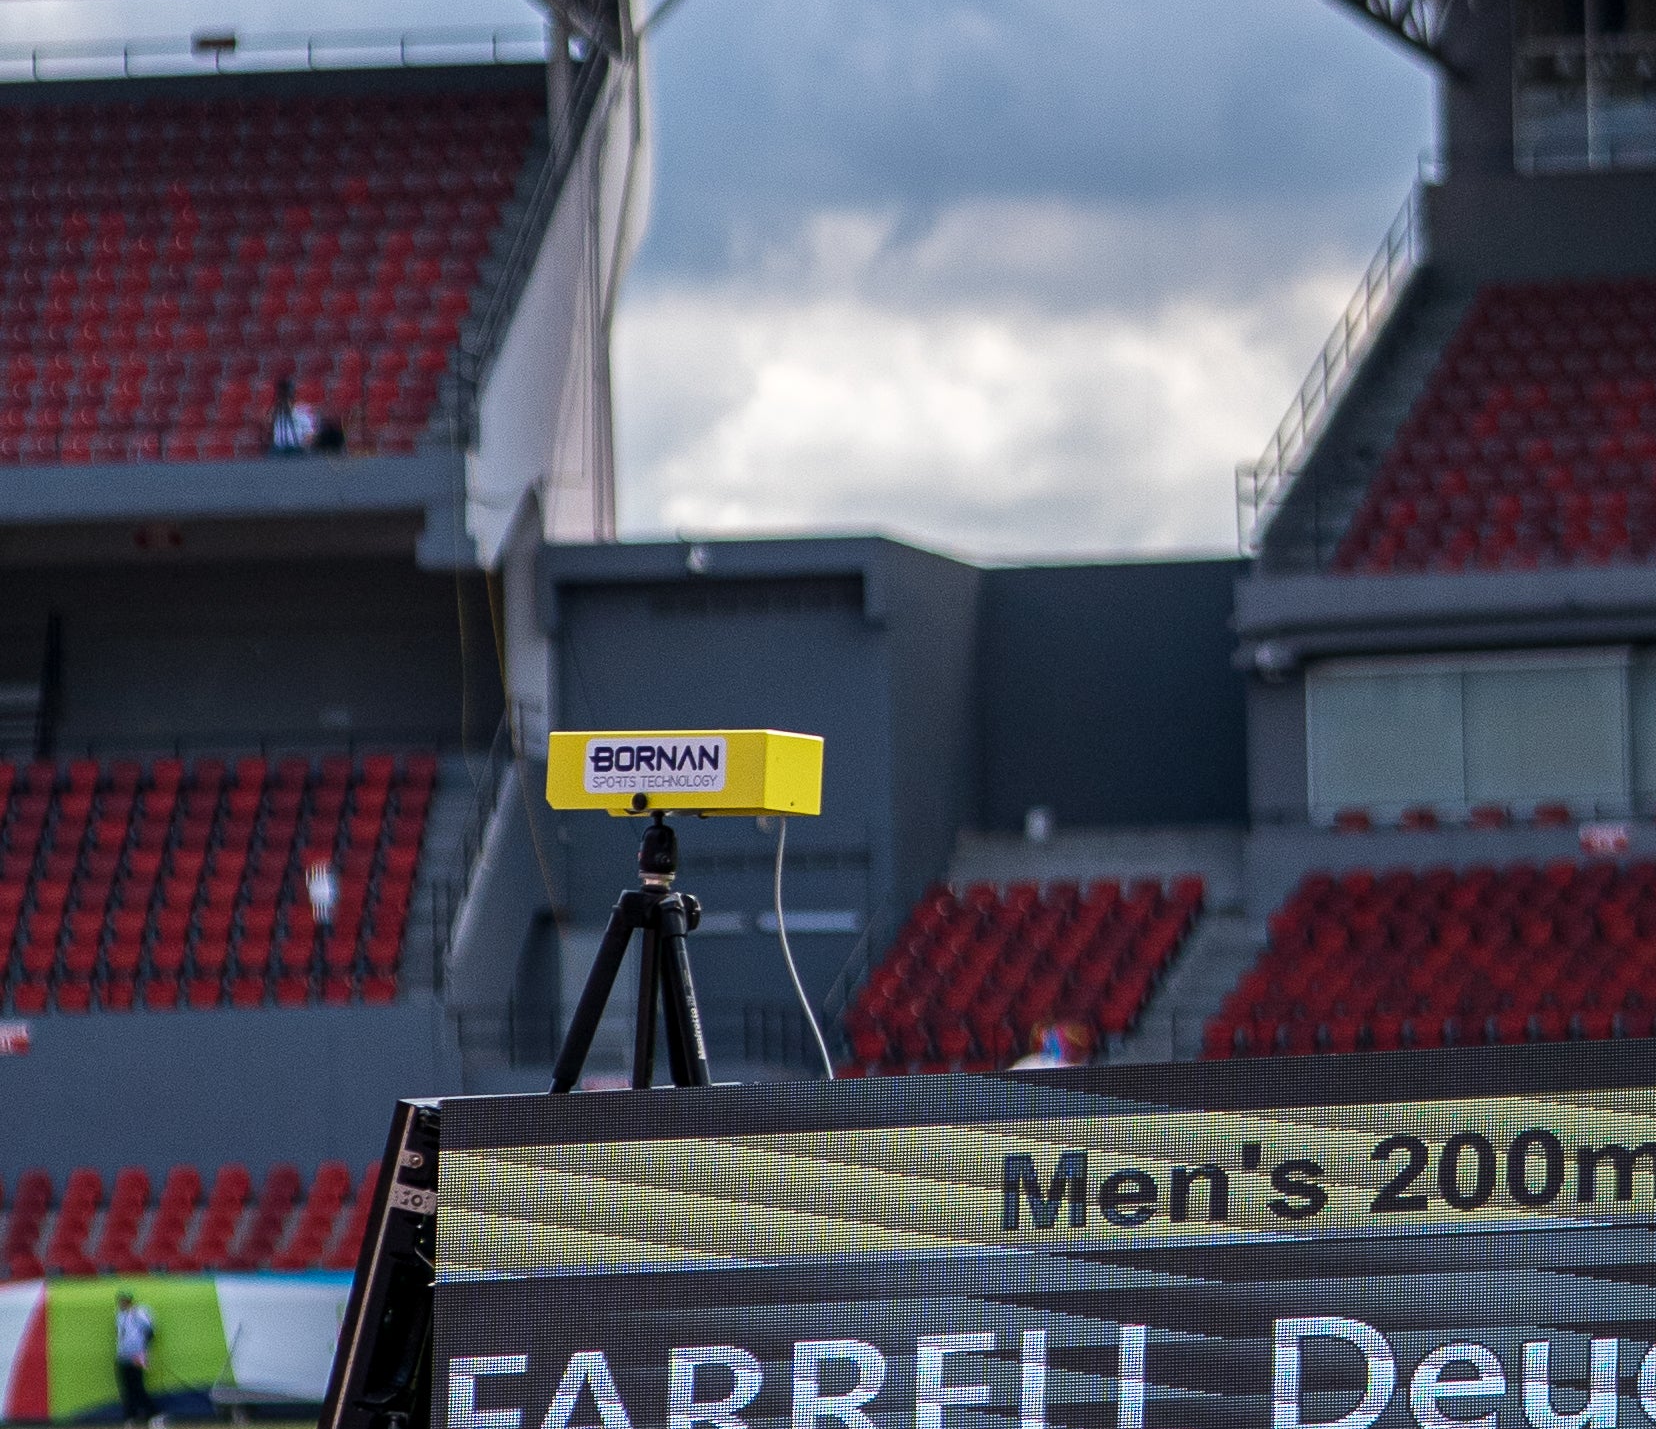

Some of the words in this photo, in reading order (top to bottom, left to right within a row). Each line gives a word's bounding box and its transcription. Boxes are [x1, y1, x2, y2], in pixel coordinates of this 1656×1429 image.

[589, 745, 719, 773] BORNAN
[592, 776, 636, 789] SPORTS
[640, 775, 718, 788] TECHNOLOGY
[1000, 1141, 1327, 1231] Men's
